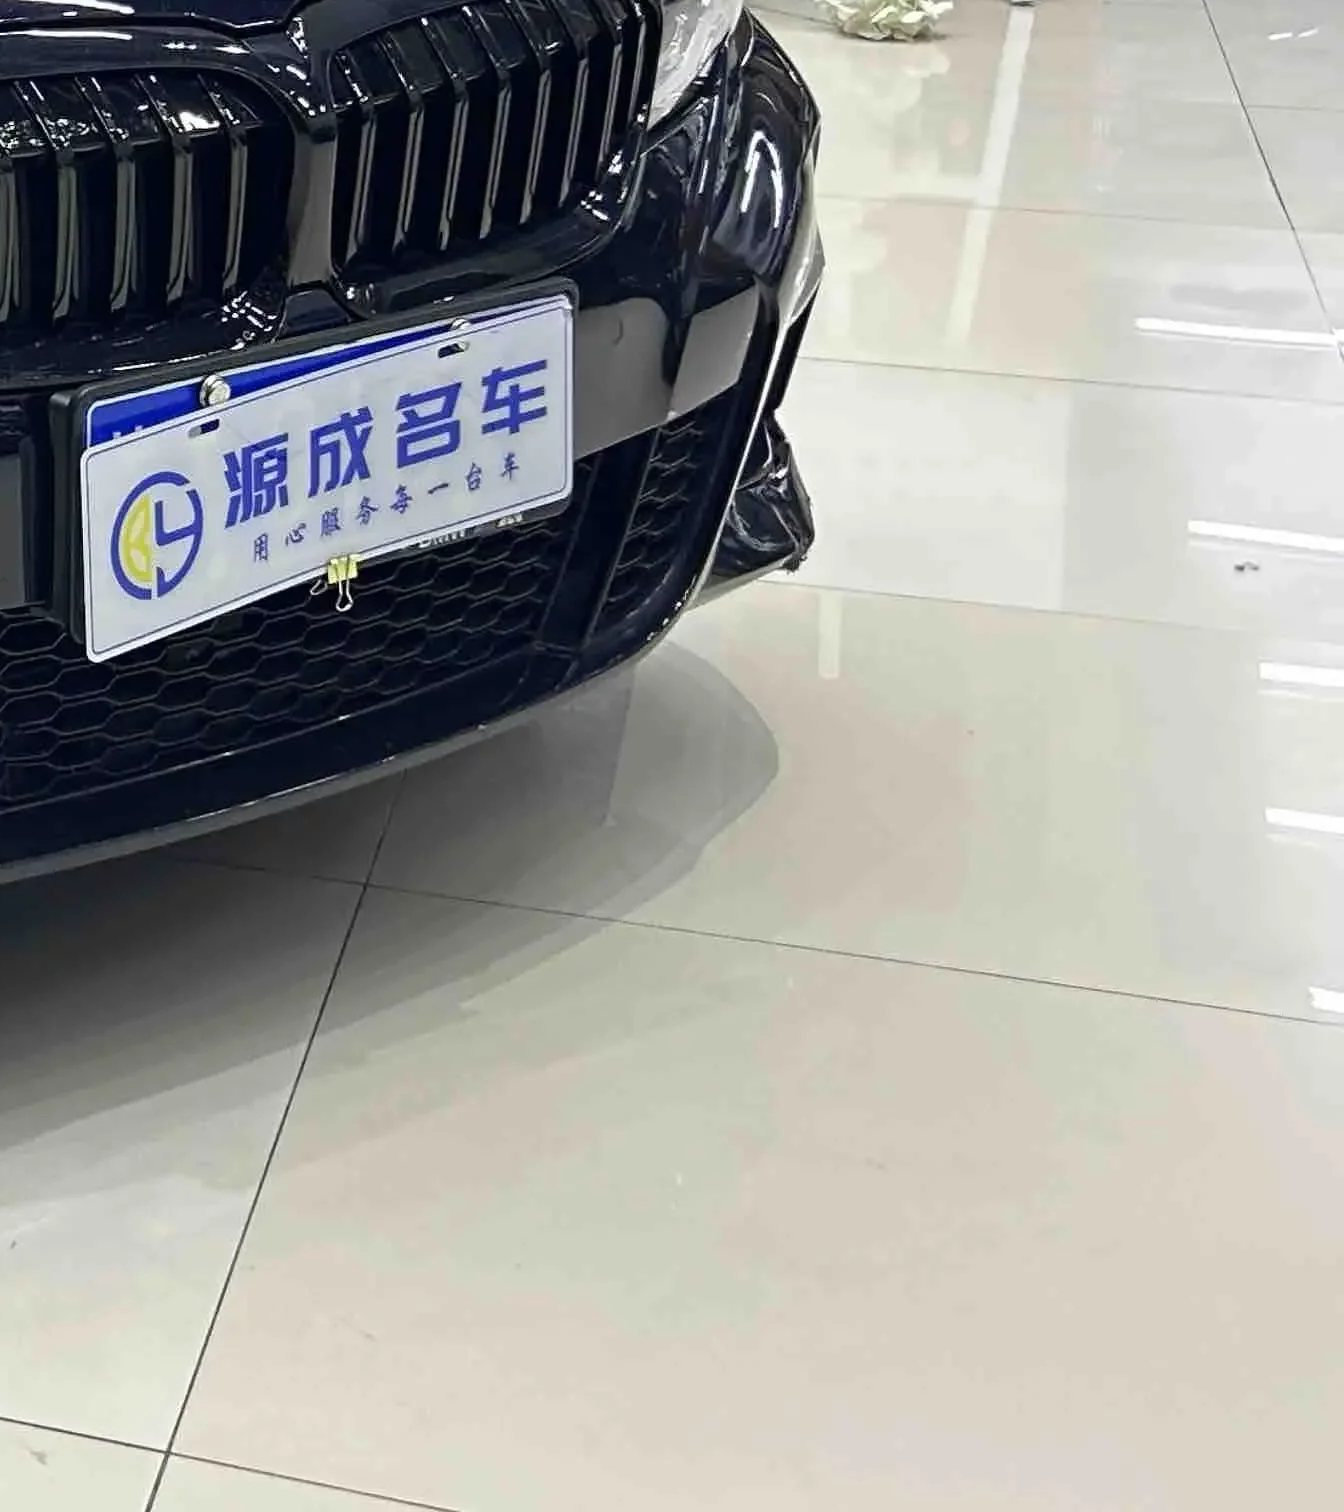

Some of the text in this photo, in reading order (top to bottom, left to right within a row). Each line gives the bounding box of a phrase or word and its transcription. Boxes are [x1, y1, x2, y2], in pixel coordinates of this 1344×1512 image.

[223, 359, 548, 528] 源成名车
[253, 451, 520, 564] 用心服务每一台车
